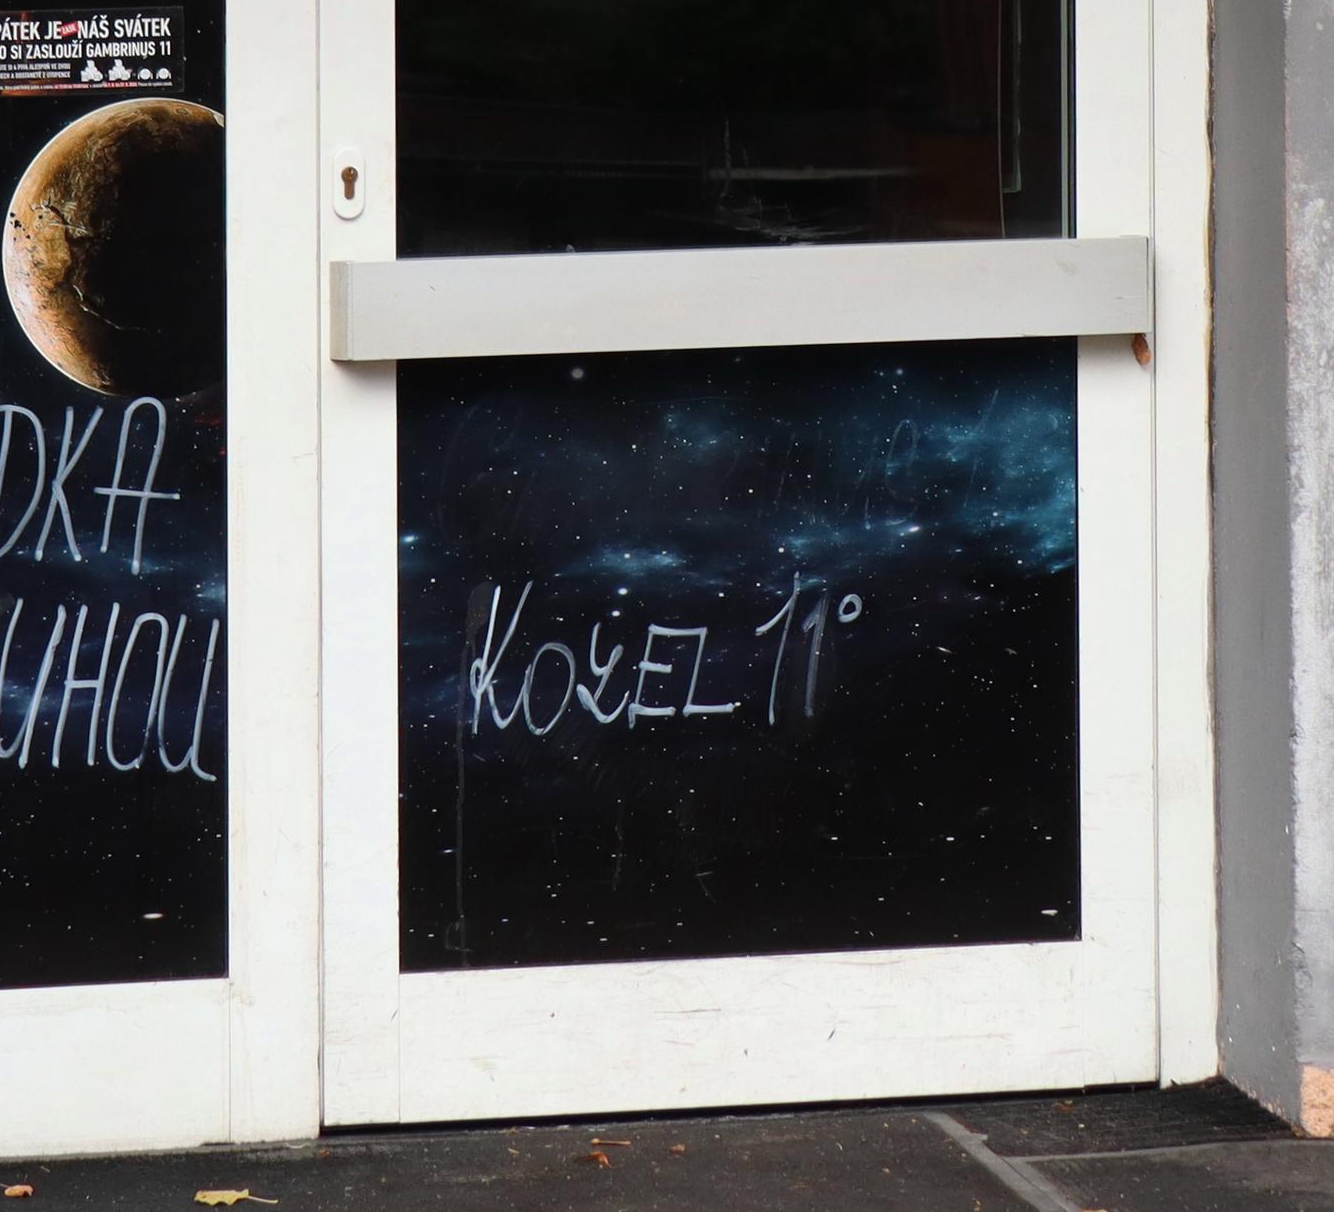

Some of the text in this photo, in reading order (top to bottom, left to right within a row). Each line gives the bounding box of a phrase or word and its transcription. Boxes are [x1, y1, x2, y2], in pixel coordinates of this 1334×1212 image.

[44, 21, 62, 40] JE
[77, 15, 110, 40] NÁŠ
[114, 14, 172, 38] SVÁTEK
[10, 45, 23, 60] SI
[26, 39, 83, 60] ZASLOUŽÍ
[86, 40, 156, 59] GAMBRINUS
[160, 40, 172, 56] 11
[469, 579, 741, 736] KOZEL
